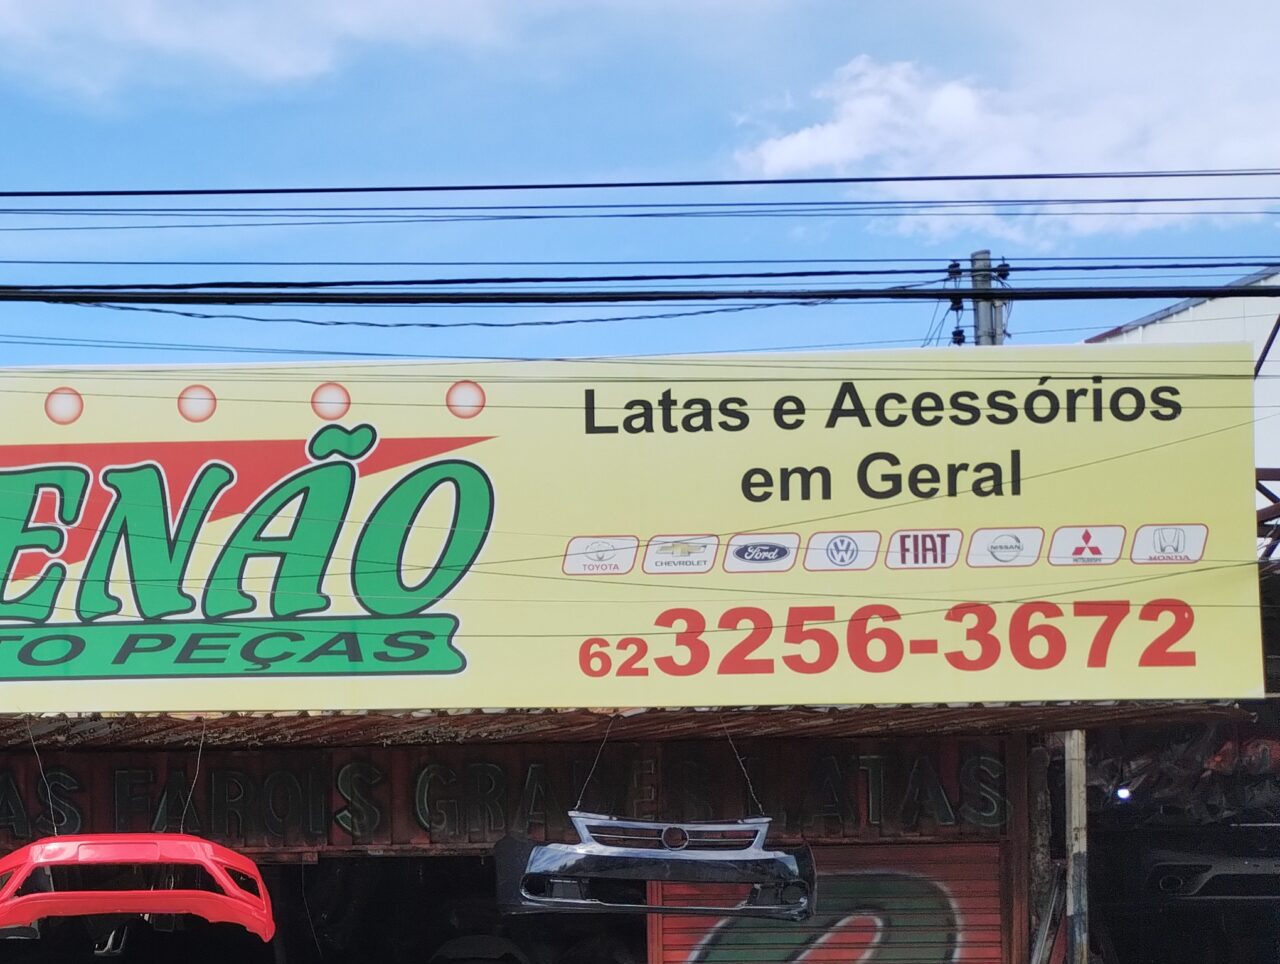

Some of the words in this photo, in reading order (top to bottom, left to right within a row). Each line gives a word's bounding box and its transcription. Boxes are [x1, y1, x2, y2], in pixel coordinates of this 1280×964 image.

[584, 388, 750, 434] Latas
[773, 395, 806, 430] e
[825, 374, 1183, 429] Acessórios
[741, 466, 832, 503] em
[857, 449, 1021, 500] Geral
[654, 559, 709, 568] CHEVROLET
[744, 545, 780, 560] Ford
[899, 533, 950, 565] FIAT
[582, 562, 620, 571] TOYOTA
[110, 630, 438, 671] PEÇAS
